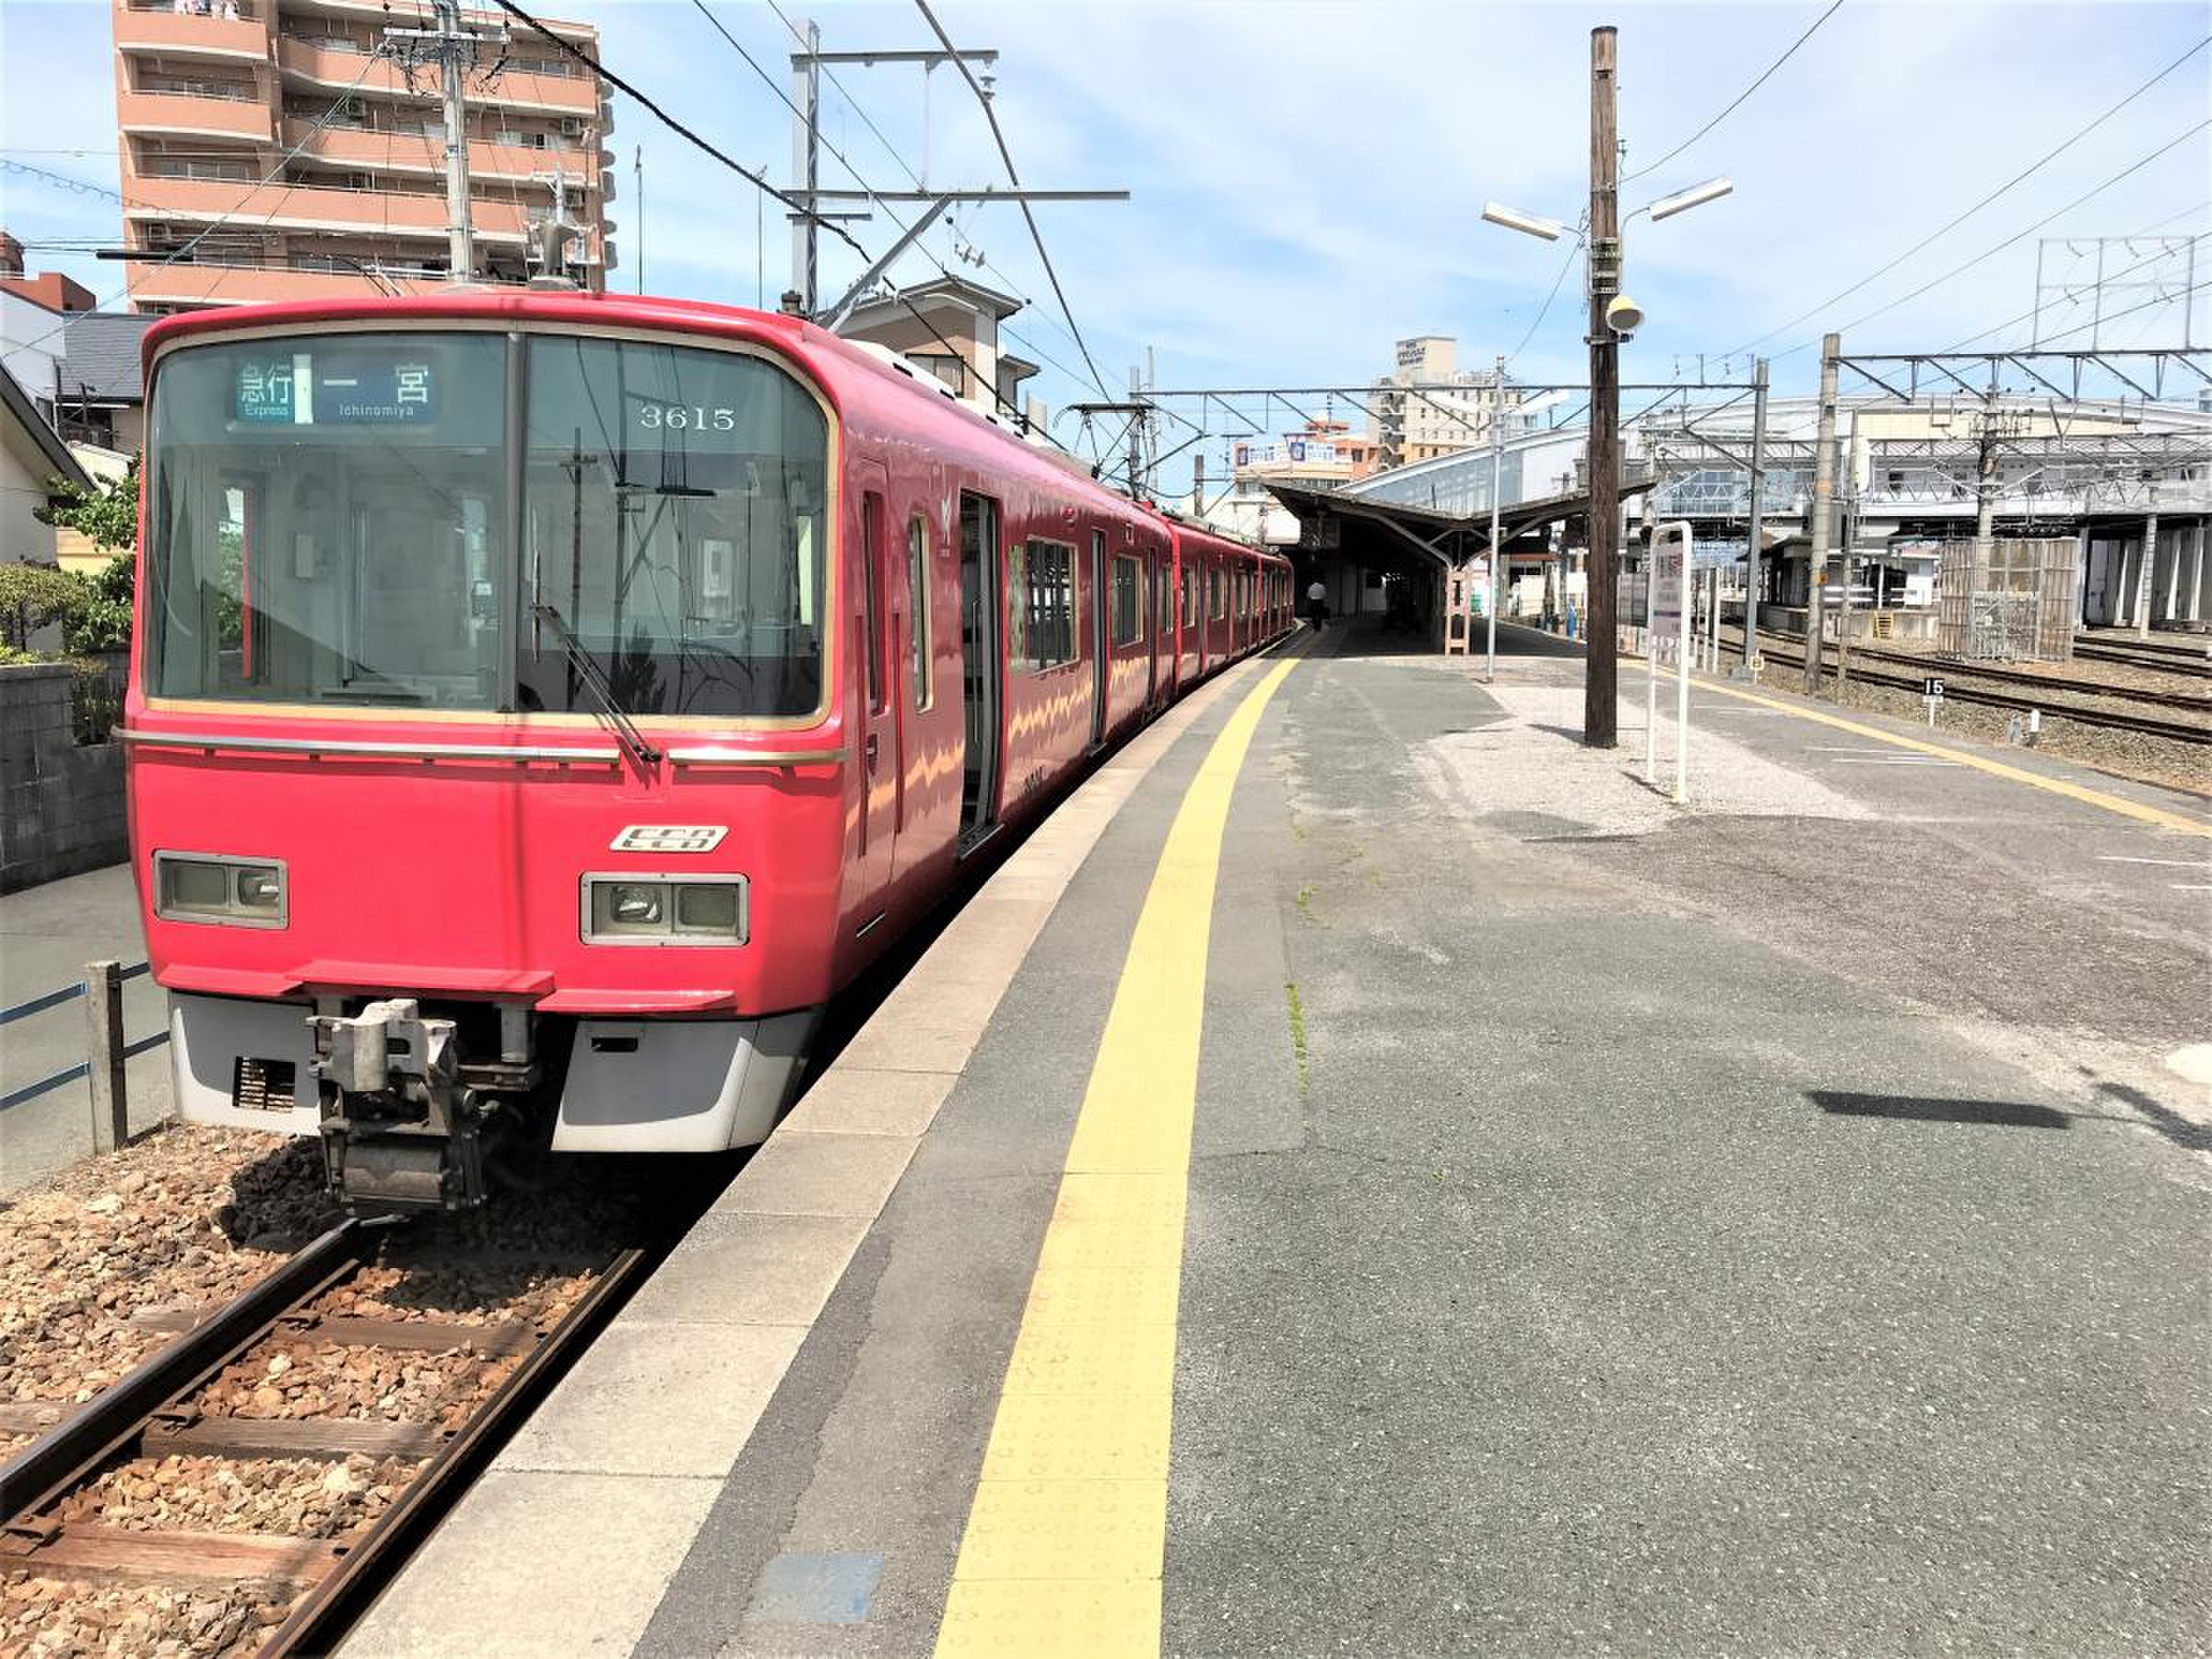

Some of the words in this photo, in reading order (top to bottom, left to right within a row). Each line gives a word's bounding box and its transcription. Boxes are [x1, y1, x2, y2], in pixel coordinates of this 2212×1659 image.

[241, 363, 292, 404] 急行
[324, 363, 429, 404] 一宮
[244, 403, 288, 417] Express
[339, 403, 414, 418] Ichinomiya
[641, 405, 735, 429] 3615
[1926, 678, 1944, 694] 15
